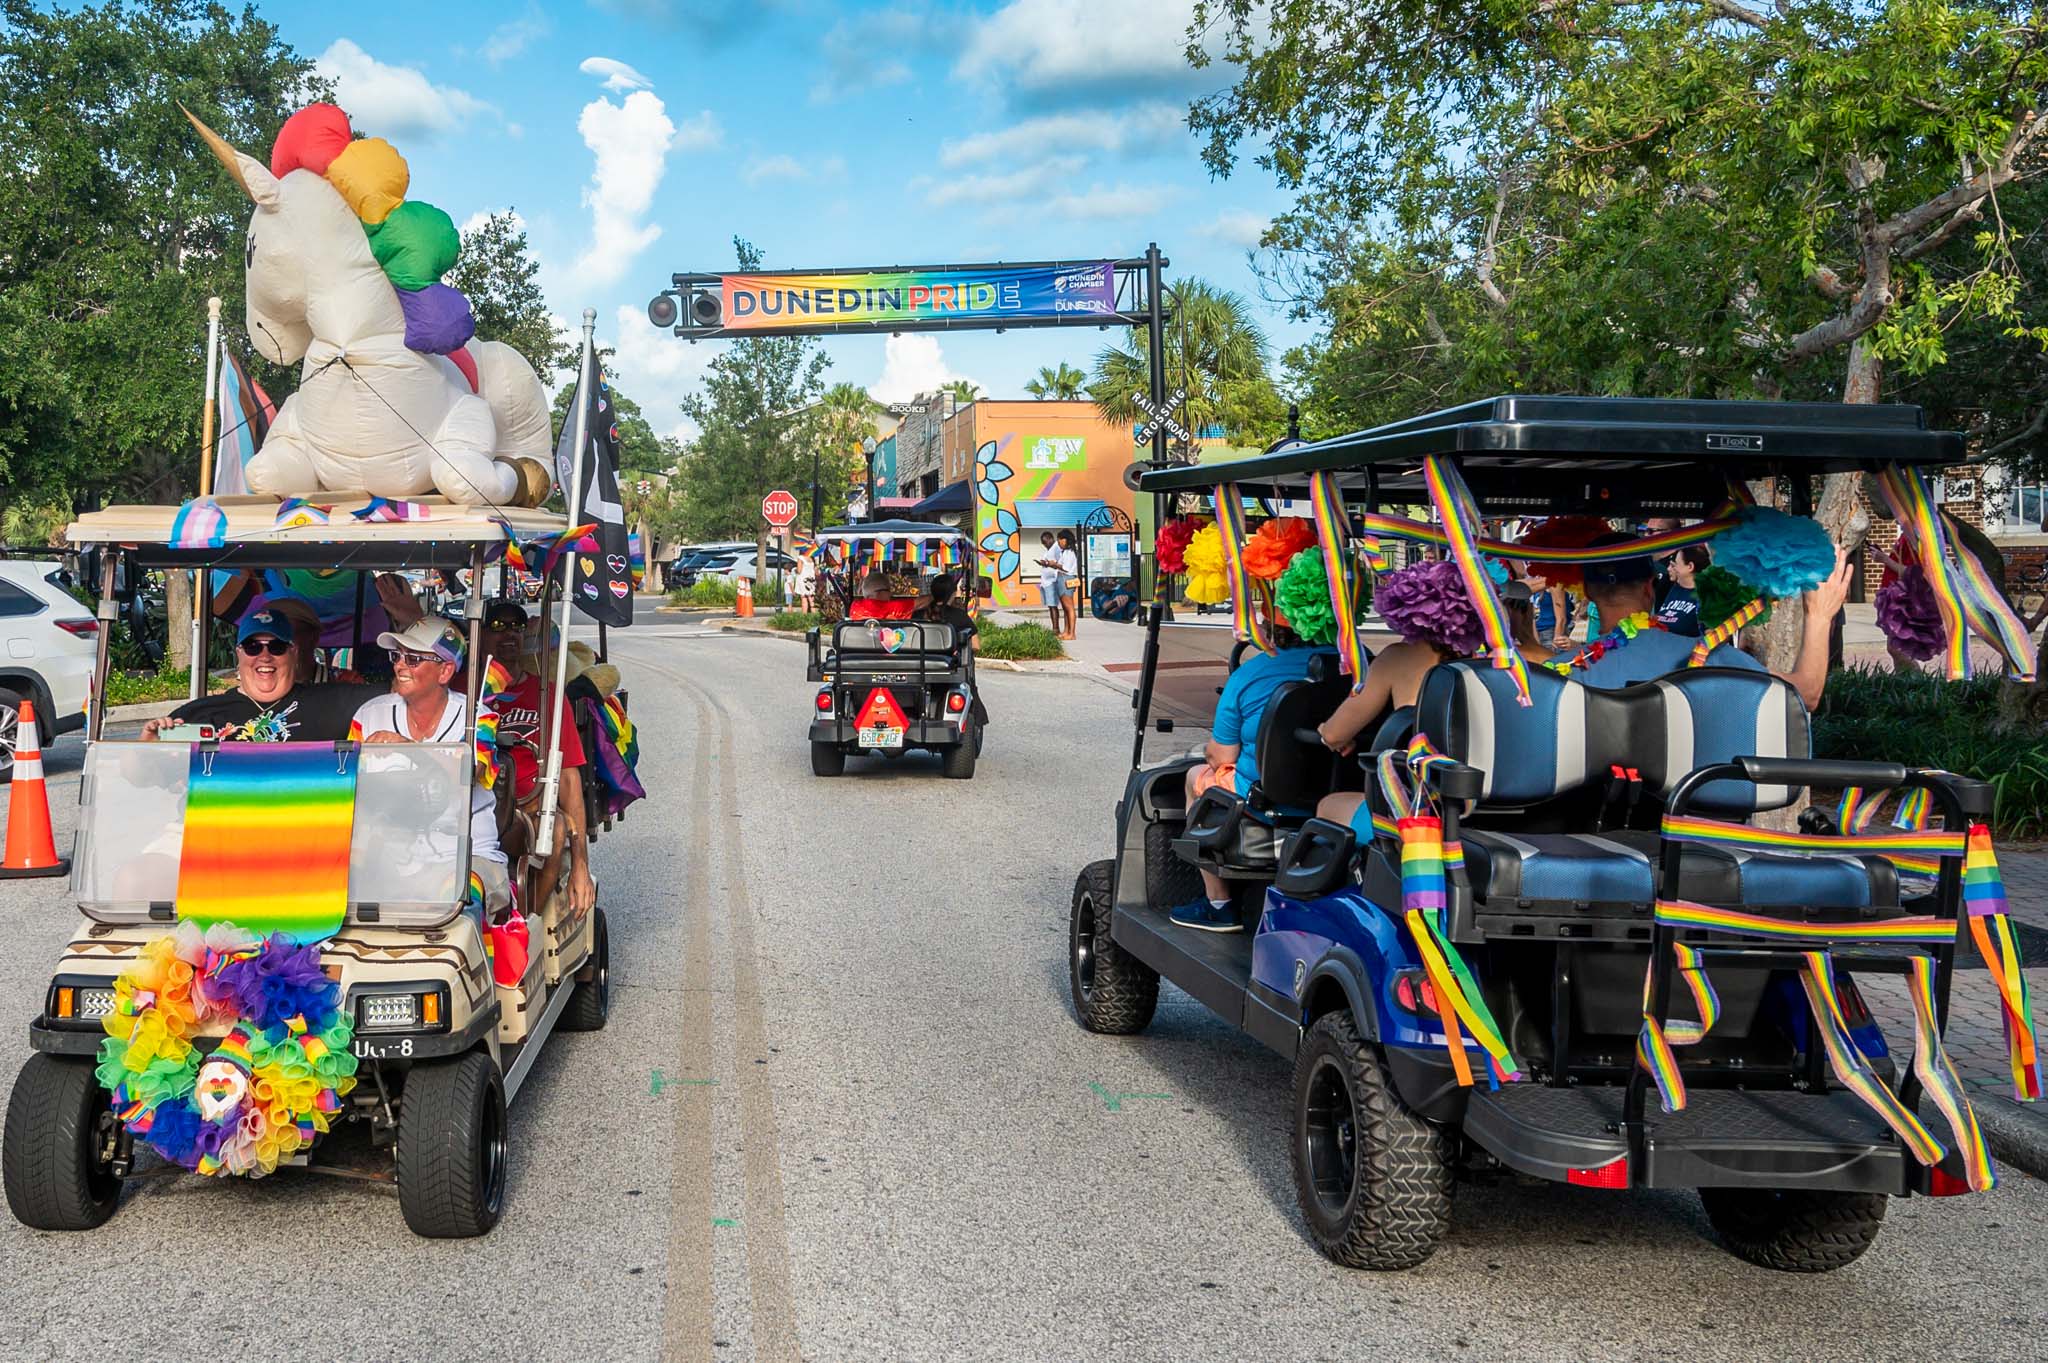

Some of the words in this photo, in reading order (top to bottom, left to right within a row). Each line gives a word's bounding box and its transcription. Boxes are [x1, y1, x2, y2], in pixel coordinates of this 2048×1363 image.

[1069, 273, 1105, 282] DUNEDIN
[1069, 281, 1105, 289] CHAMBER
[732, 287, 902, 318] DUNEDIN
[908, 280, 1022, 312] PRIDE
[890, 405, 926, 413] BOOKS
[1131, 392, 1156, 416] RAIL
[1164, 418, 1190, 442] ROAD
[1137, 389, 1185, 444] CROSSING
[765, 501, 795, 515] STOP
